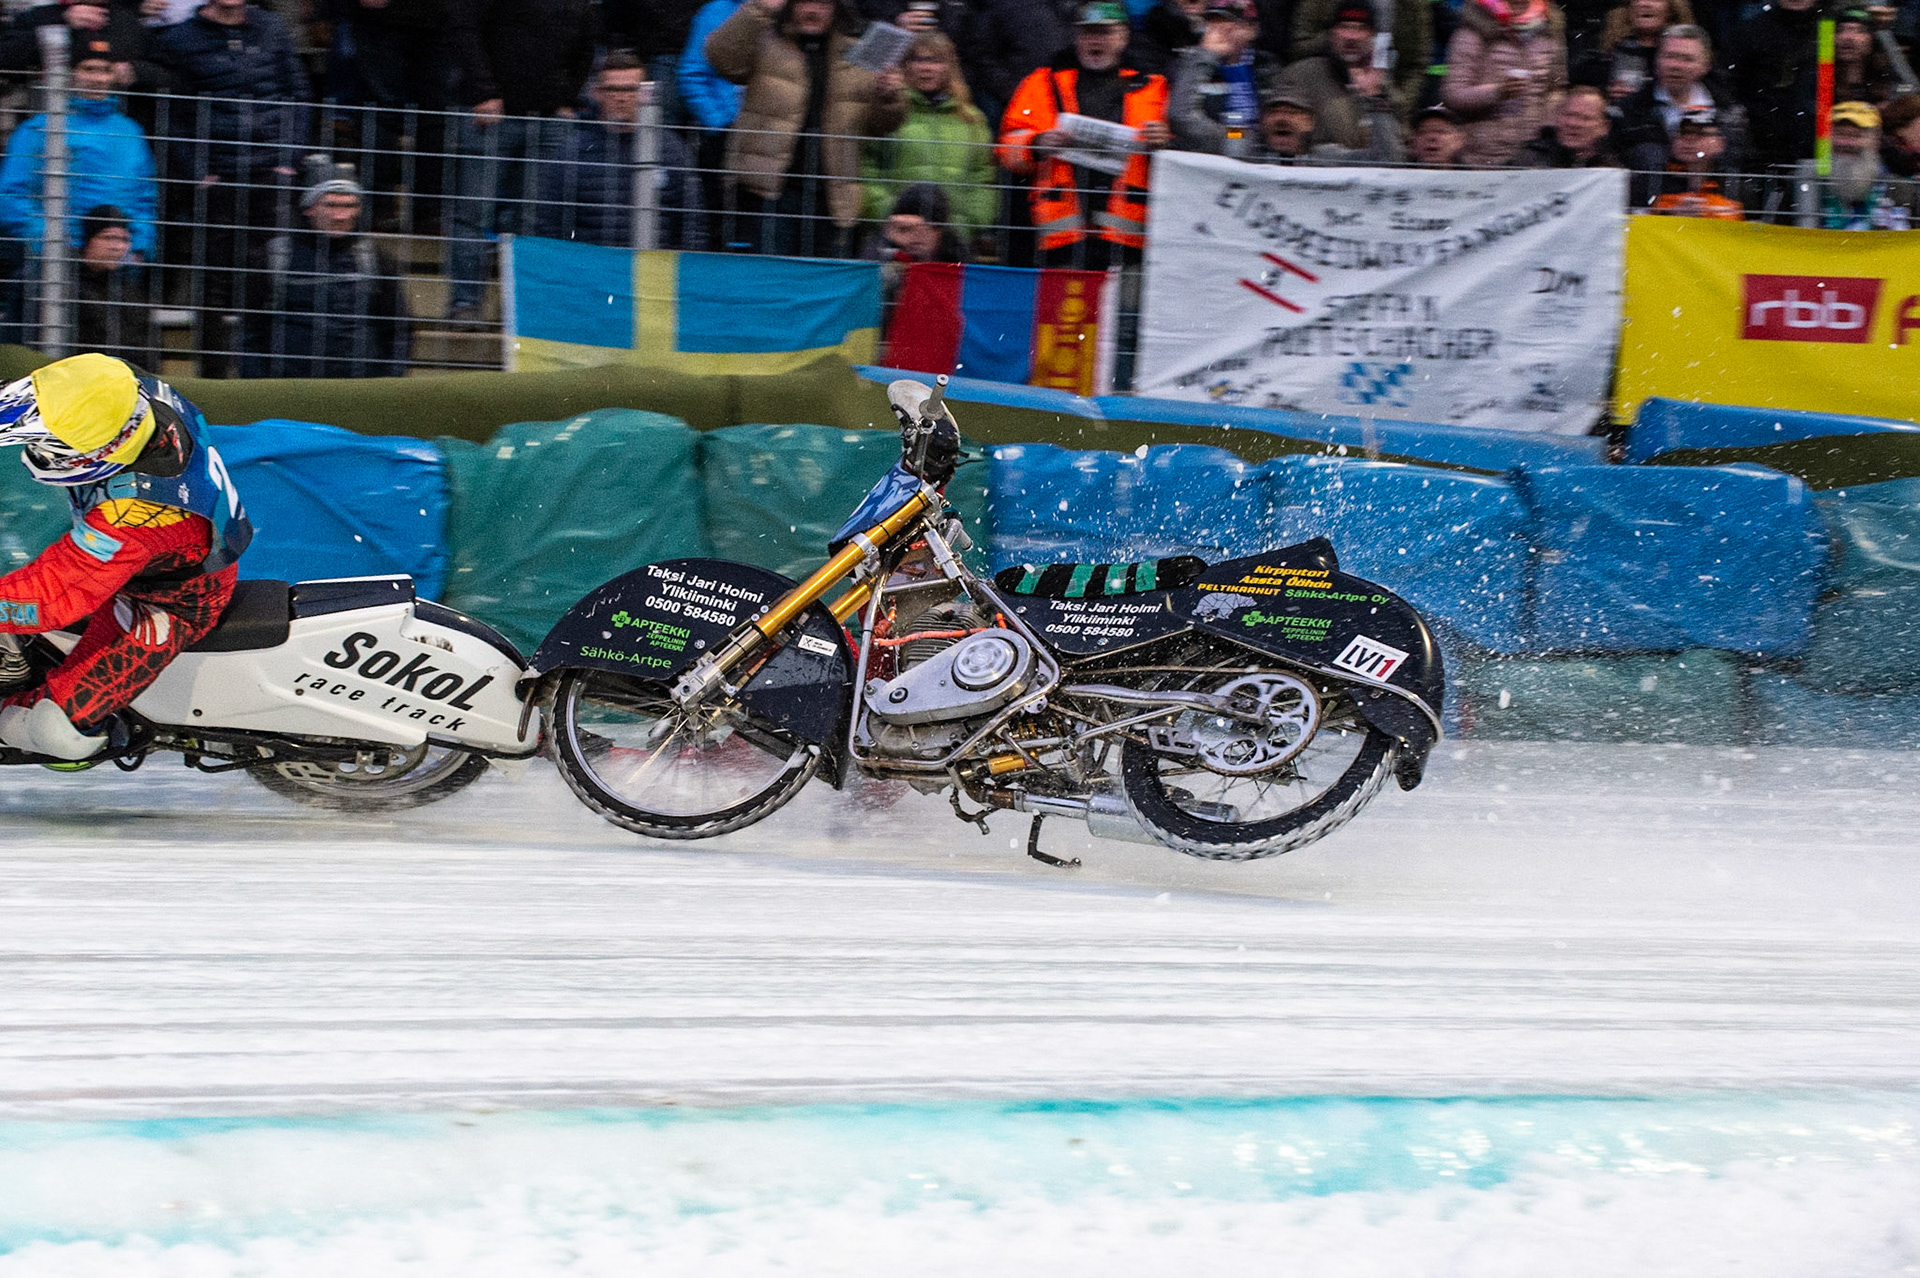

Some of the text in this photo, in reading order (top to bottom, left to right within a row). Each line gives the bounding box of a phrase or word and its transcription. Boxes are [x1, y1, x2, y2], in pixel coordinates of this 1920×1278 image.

[1751, 289, 1866, 330] rbb
[1239, 575, 1283, 587] Aasta
[1253, 565, 1330, 578] Kirpputori
[647, 565, 764, 604] Taksi Jari Holmi
[1197, 582, 1390, 605] PELTIKARHUT Sähkö-Artpe Oy
[661, 583, 738, 612] Ylikiiminki
[1049, 600, 1162, 614] Taksi Jari Holmi
[645, 596, 736, 627] 0500 584580
[1062, 613, 1137, 626] Ylikiiminki
[1263, 615, 1332, 629] APTEEKKI
[1045, 624, 1134, 637] 0500 584580
[1285, 633, 1324, 642] APTEEKKI
[580, 645, 673, 669] Sähkö-Artpe
[650, 640, 684, 652] APTEEKKI
[323, 631, 494, 711] Sokol
[1341, 644, 1397, 678] LVI1
[294, 672, 466, 732] race track
